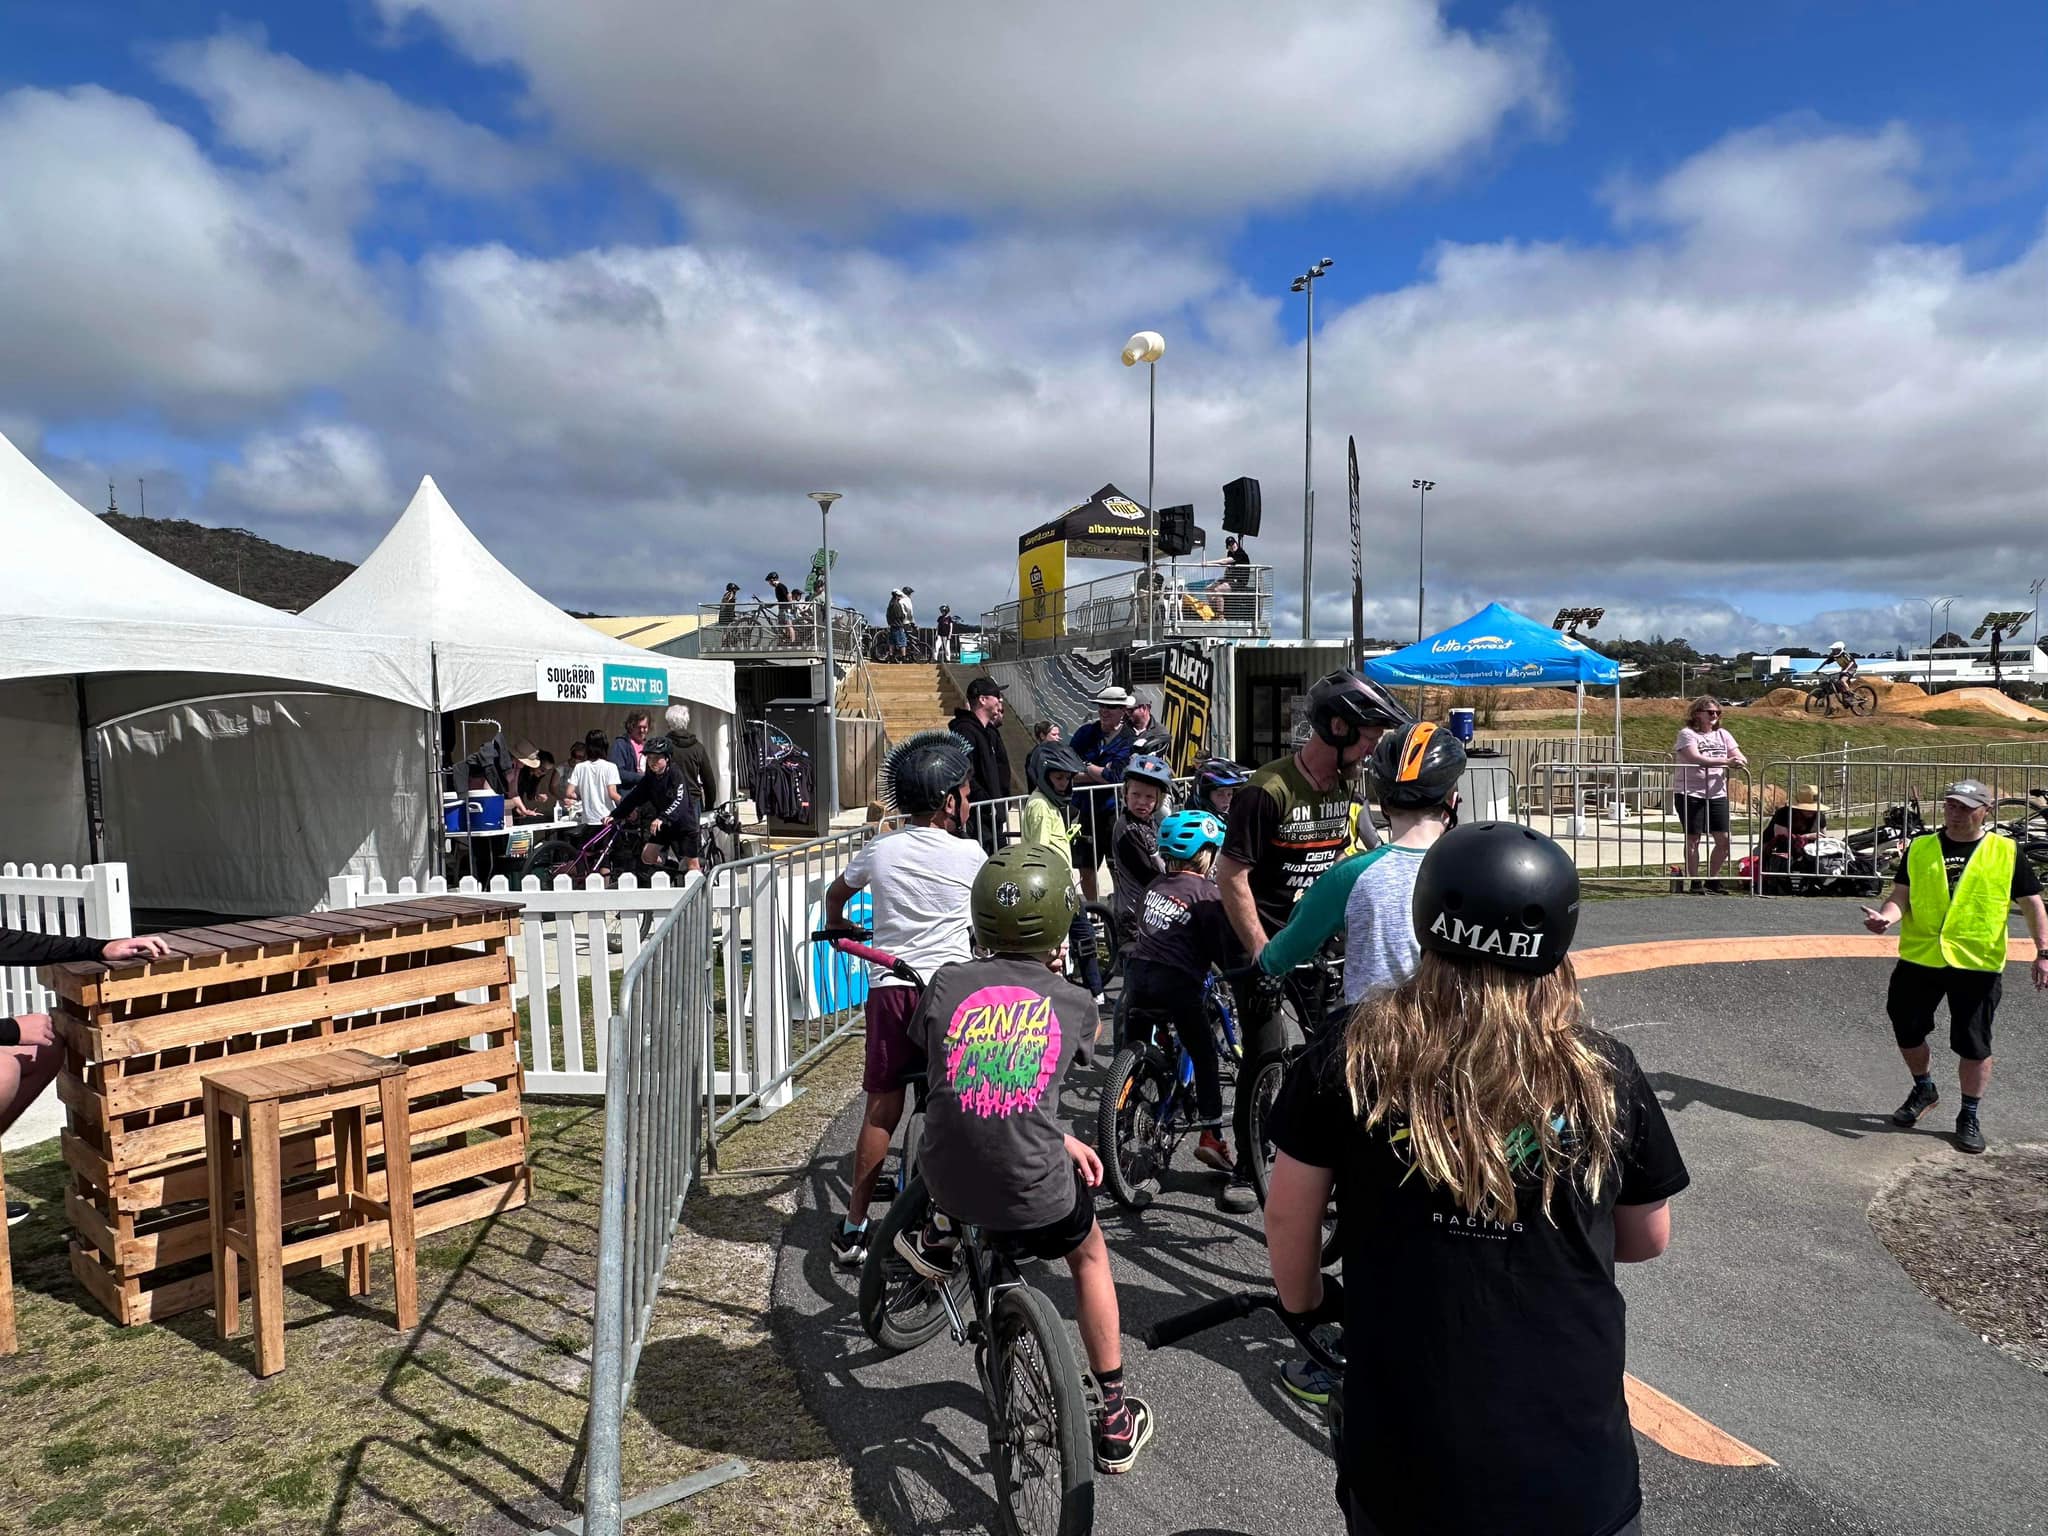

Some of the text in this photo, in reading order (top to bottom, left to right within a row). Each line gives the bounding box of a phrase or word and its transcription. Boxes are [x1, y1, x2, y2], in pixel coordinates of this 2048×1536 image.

[1088, 524, 1160, 537] albanymtb.co
[610, 676, 647, 693] EVENT
[1292, 804, 1311, 821] ON
[1429, 911, 1544, 958] AMARI
[944, 996, 1052, 1043] SANTA
[1432, 1212, 1524, 1232] RACING
